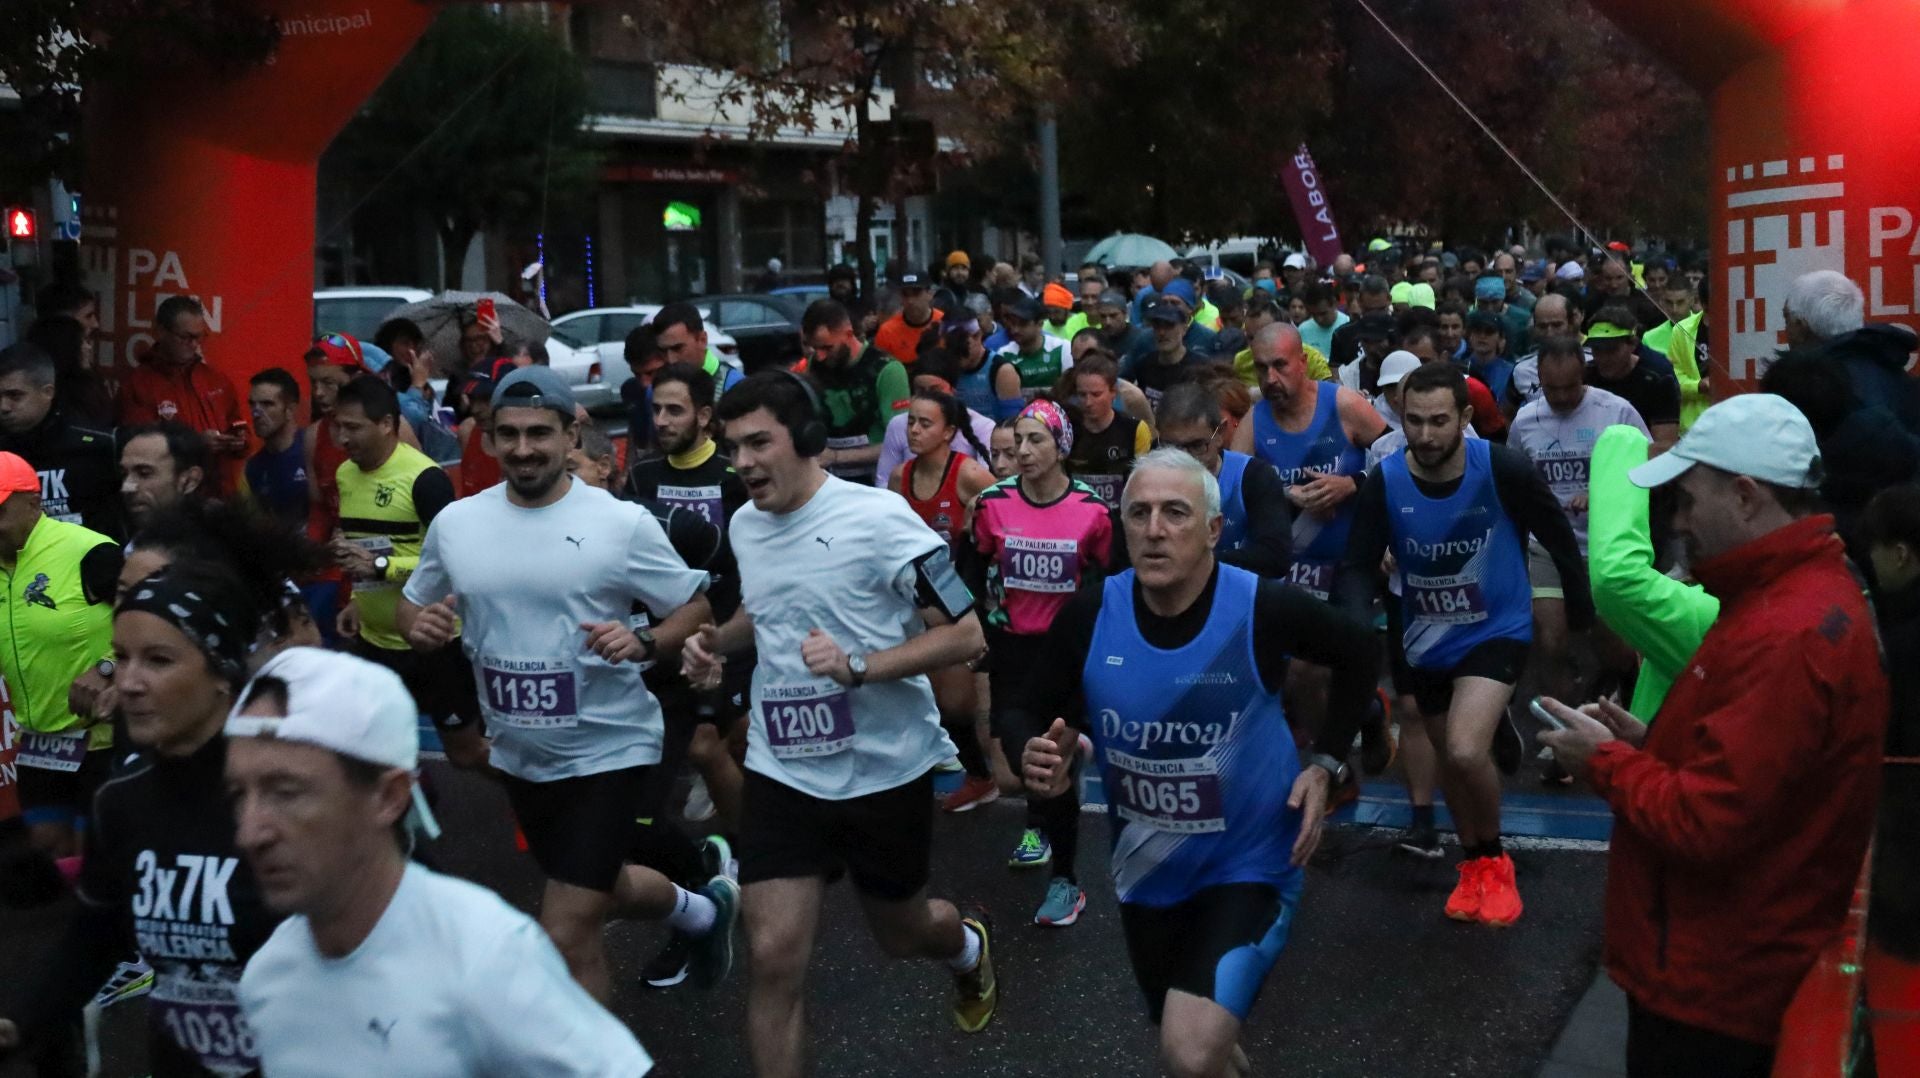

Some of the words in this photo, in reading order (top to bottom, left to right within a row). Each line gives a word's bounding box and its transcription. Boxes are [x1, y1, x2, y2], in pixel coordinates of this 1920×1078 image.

[266, 9, 373, 36] unicipal
[1294, 153, 1337, 242] LABOR
[1869, 206, 1920, 258] P
[128, 247, 189, 289] PA
[1870, 263, 1920, 316] L
[37, 468, 70, 501] 7K
[1543, 461, 1586, 481] 1092
[1096, 484, 1114, 500] 09
[1025, 541, 1057, 550] PALENCIA
[1405, 528, 1491, 562] Deproal
[1011, 551, 1063, 579] 1089
[1290, 562, 1321, 587] 121
[1423, 578, 1457, 587] PALENCIA
[1416, 588, 1470, 613] 1184
[504, 661, 546, 671] PALENCIA
[492, 675, 559, 711] 1135
[779, 686, 817, 698] PALENCIA
[770, 703, 835, 739] 1200
[1100, 708, 1239, 750] Deproal
[1134, 760, 1186, 773] PALENCIA
[1120, 774, 1201, 814] 1065
[132, 849, 240, 926] 3x7K
[135, 932, 239, 962] PALENCIA
